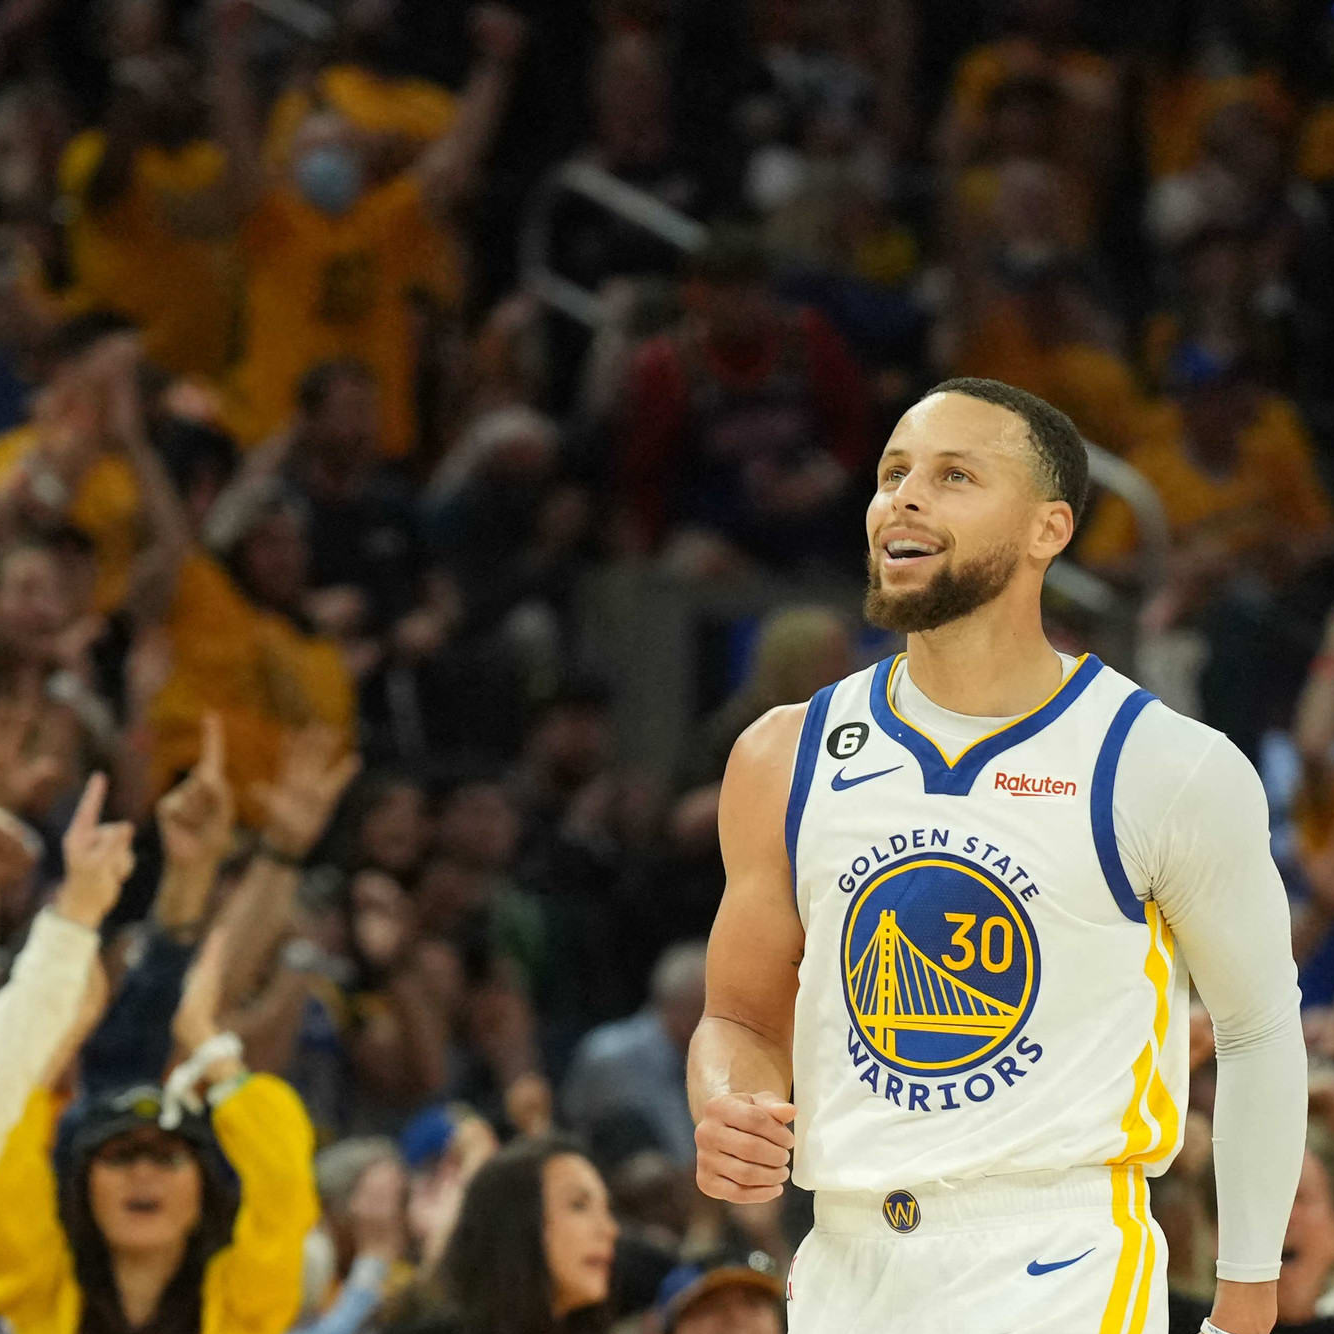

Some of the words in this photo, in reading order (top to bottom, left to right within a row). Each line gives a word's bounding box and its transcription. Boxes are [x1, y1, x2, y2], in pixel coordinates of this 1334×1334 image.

[837, 728, 861, 755] 6
[995, 772, 1077, 796] Rakuten
[838, 829, 951, 894] GOLDEN
[963, 836, 1041, 902] STATE
[941, 913, 1014, 973] 30
[848, 1026, 1043, 1112] WARRIORS
[884, 1200, 918, 1231] W
